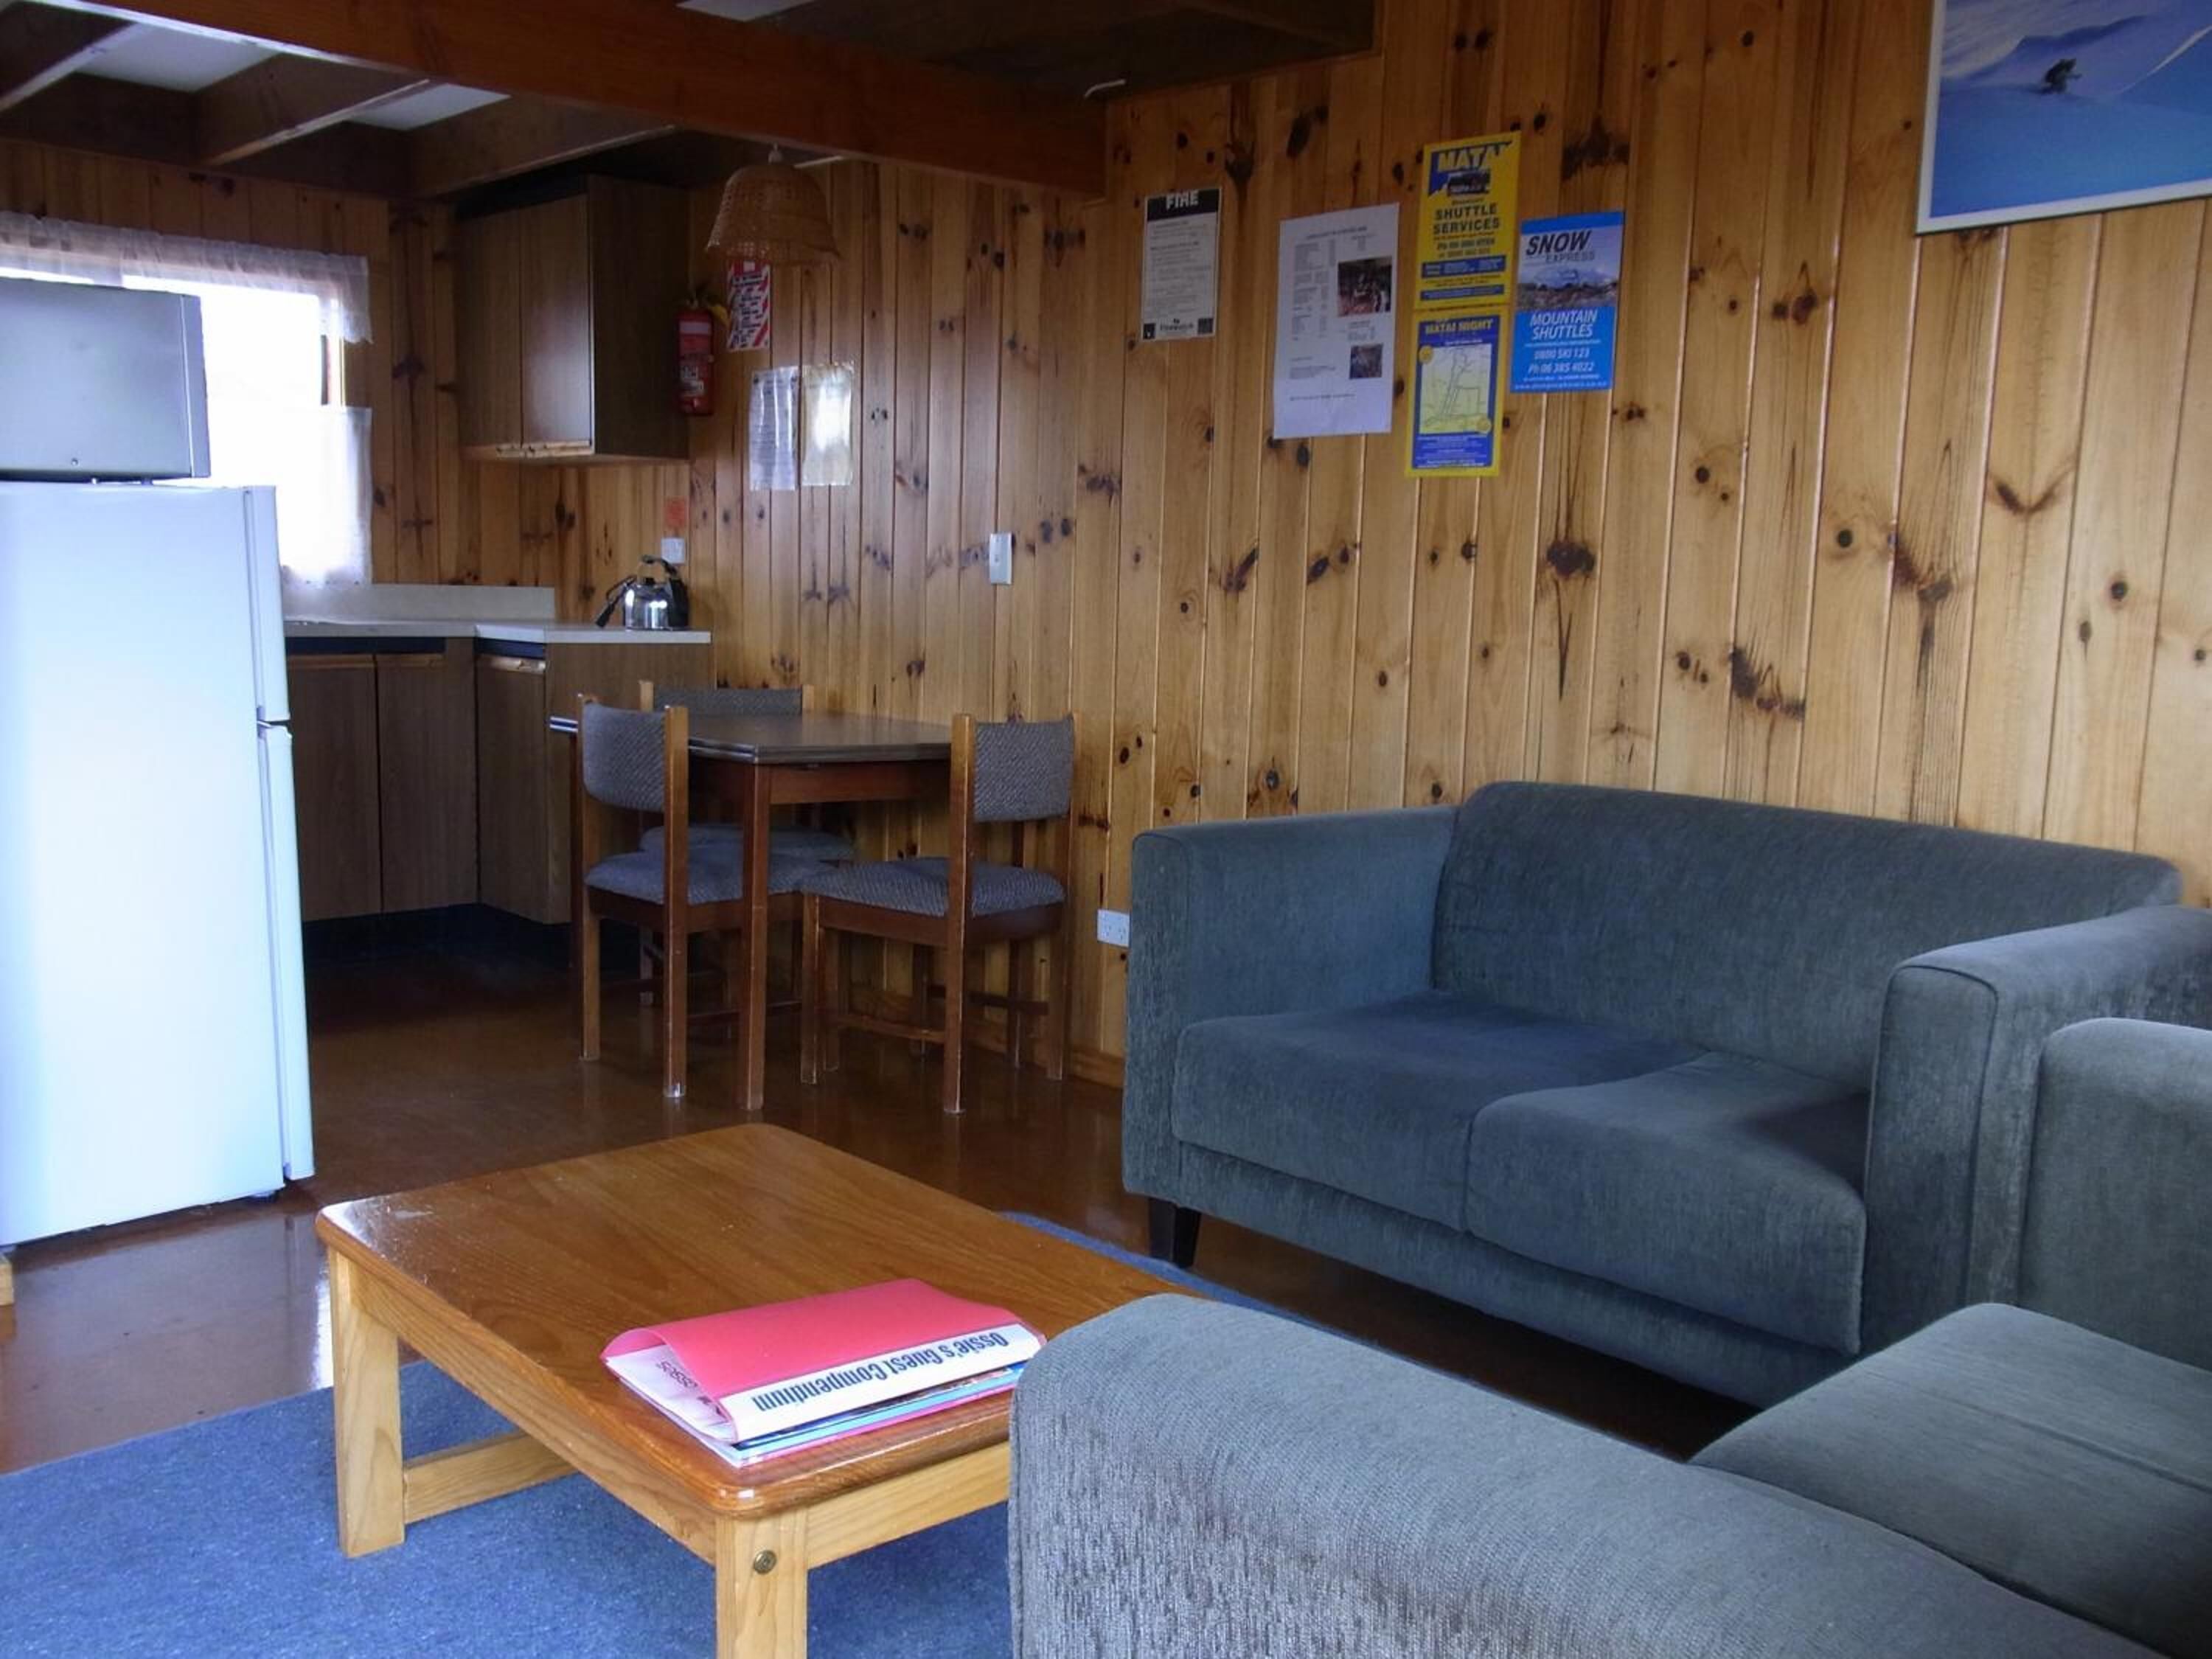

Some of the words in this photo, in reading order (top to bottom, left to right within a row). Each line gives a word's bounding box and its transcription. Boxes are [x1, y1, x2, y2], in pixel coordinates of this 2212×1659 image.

[1166, 189, 1199, 210] FIRE
[1436, 203, 1497, 220] SHUTTLE
[1433, 218, 1500, 235] SERVICES
[1526, 230, 1592, 256] SNOW
[1530, 310, 1598, 327] MOUNTAIN
[1531, 324, 1593, 341] SHUTTLES
[942, 1332, 1008, 1358] Ossie's
[884, 1348, 942, 1374] Guest
[751, 1363, 888, 1412] Compendium
